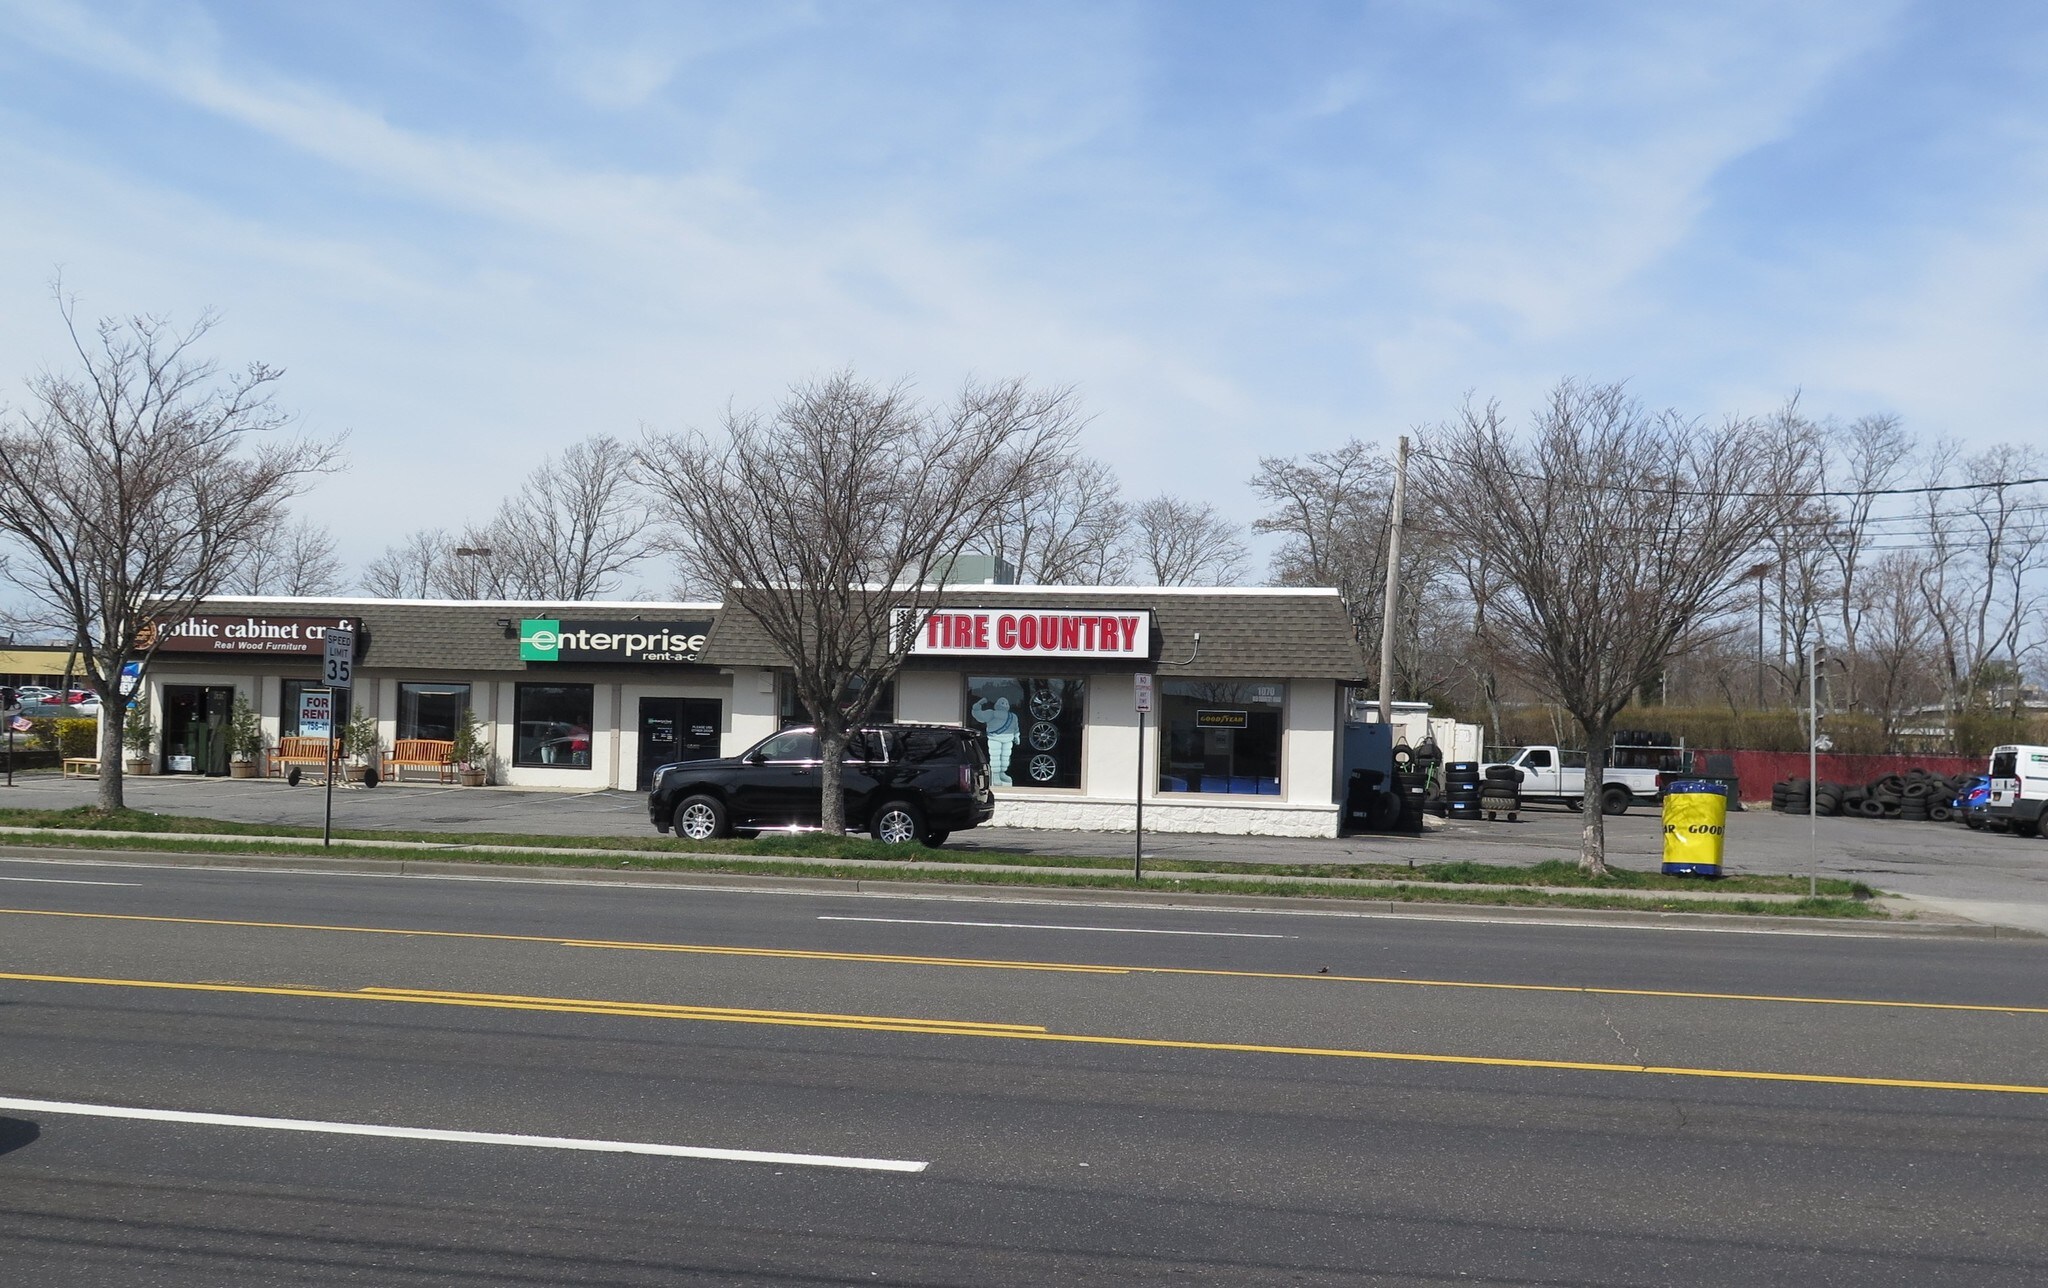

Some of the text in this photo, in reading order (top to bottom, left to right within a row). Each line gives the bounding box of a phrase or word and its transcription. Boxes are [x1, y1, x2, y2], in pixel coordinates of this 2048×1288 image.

[224, 618, 299, 639] cabinet
[305, 619, 354, 640] crf
[924, 614, 1140, 652] TIRE COUNTRY
[214, 640, 307, 651] Real Wood Furniture
[328, 634, 351, 647] SPEED
[531, 628, 707, 657] enterprise
[329, 647, 348, 658] LIMIT
[327, 659, 350, 682] 35
[1258, 687, 1275, 696] 1070
[306, 697, 329, 708] FOR
[1200, 714, 1244, 723] GOODYEAR
